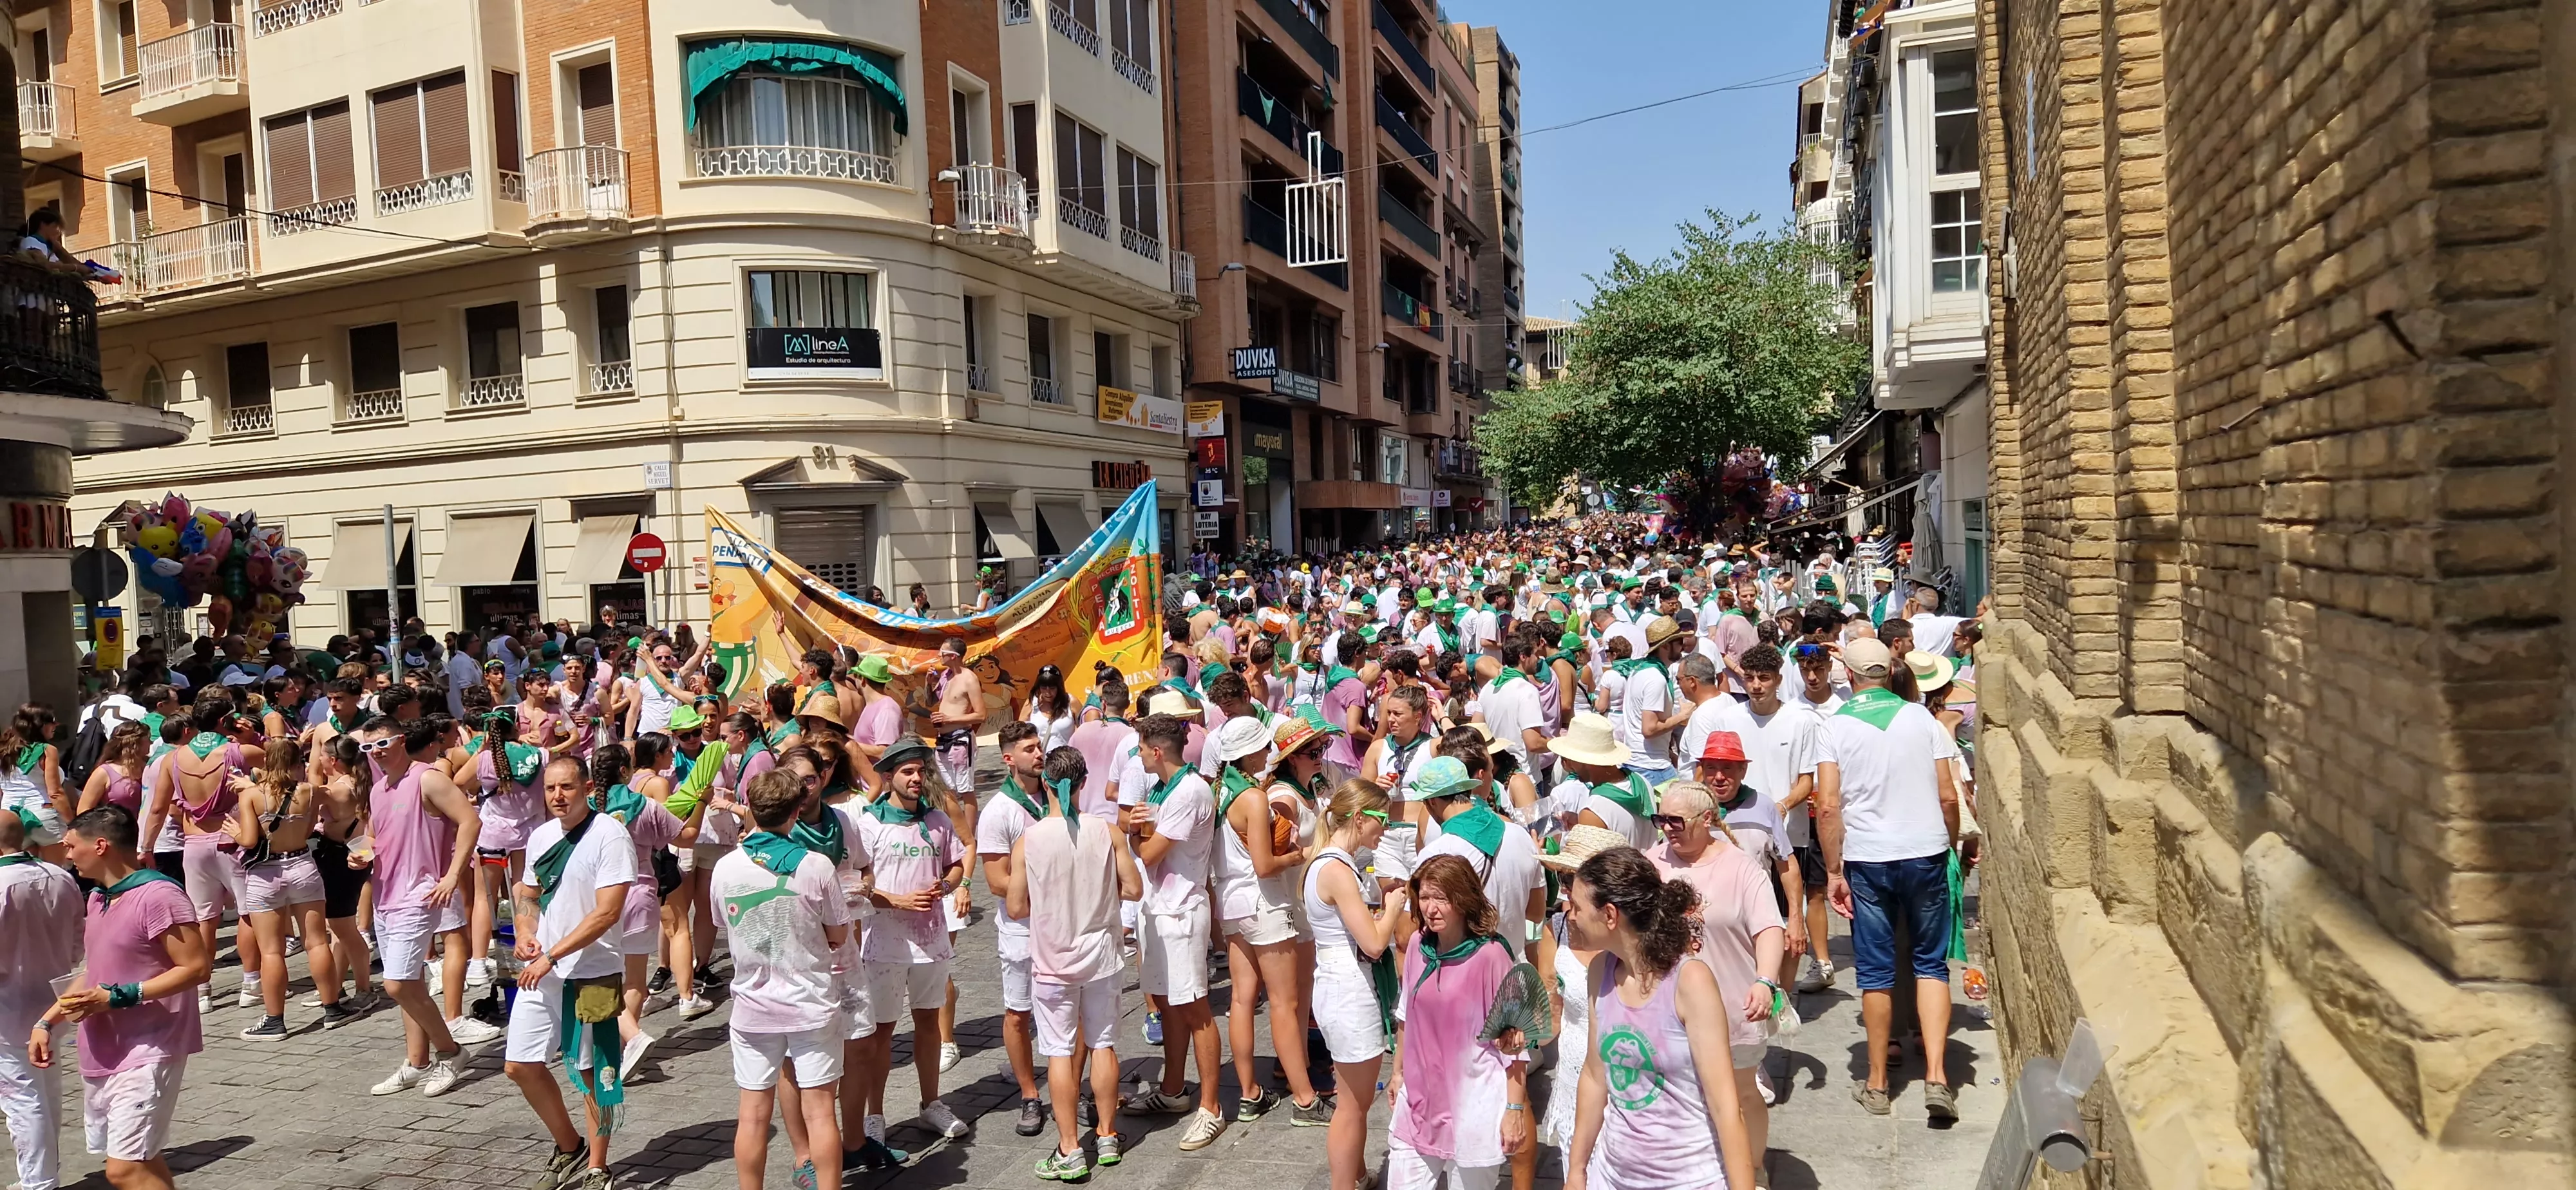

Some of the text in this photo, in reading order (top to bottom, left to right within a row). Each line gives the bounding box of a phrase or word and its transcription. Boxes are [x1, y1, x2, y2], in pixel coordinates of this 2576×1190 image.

[1236, 348, 1276, 369] DUVISA
[1236, 368, 1276, 377] ASESORES
[1255, 433, 1282, 451] mayoral
[1130, 564, 1140, 619] ZOITI
[1091, 583, 1105, 631] PEÑA
